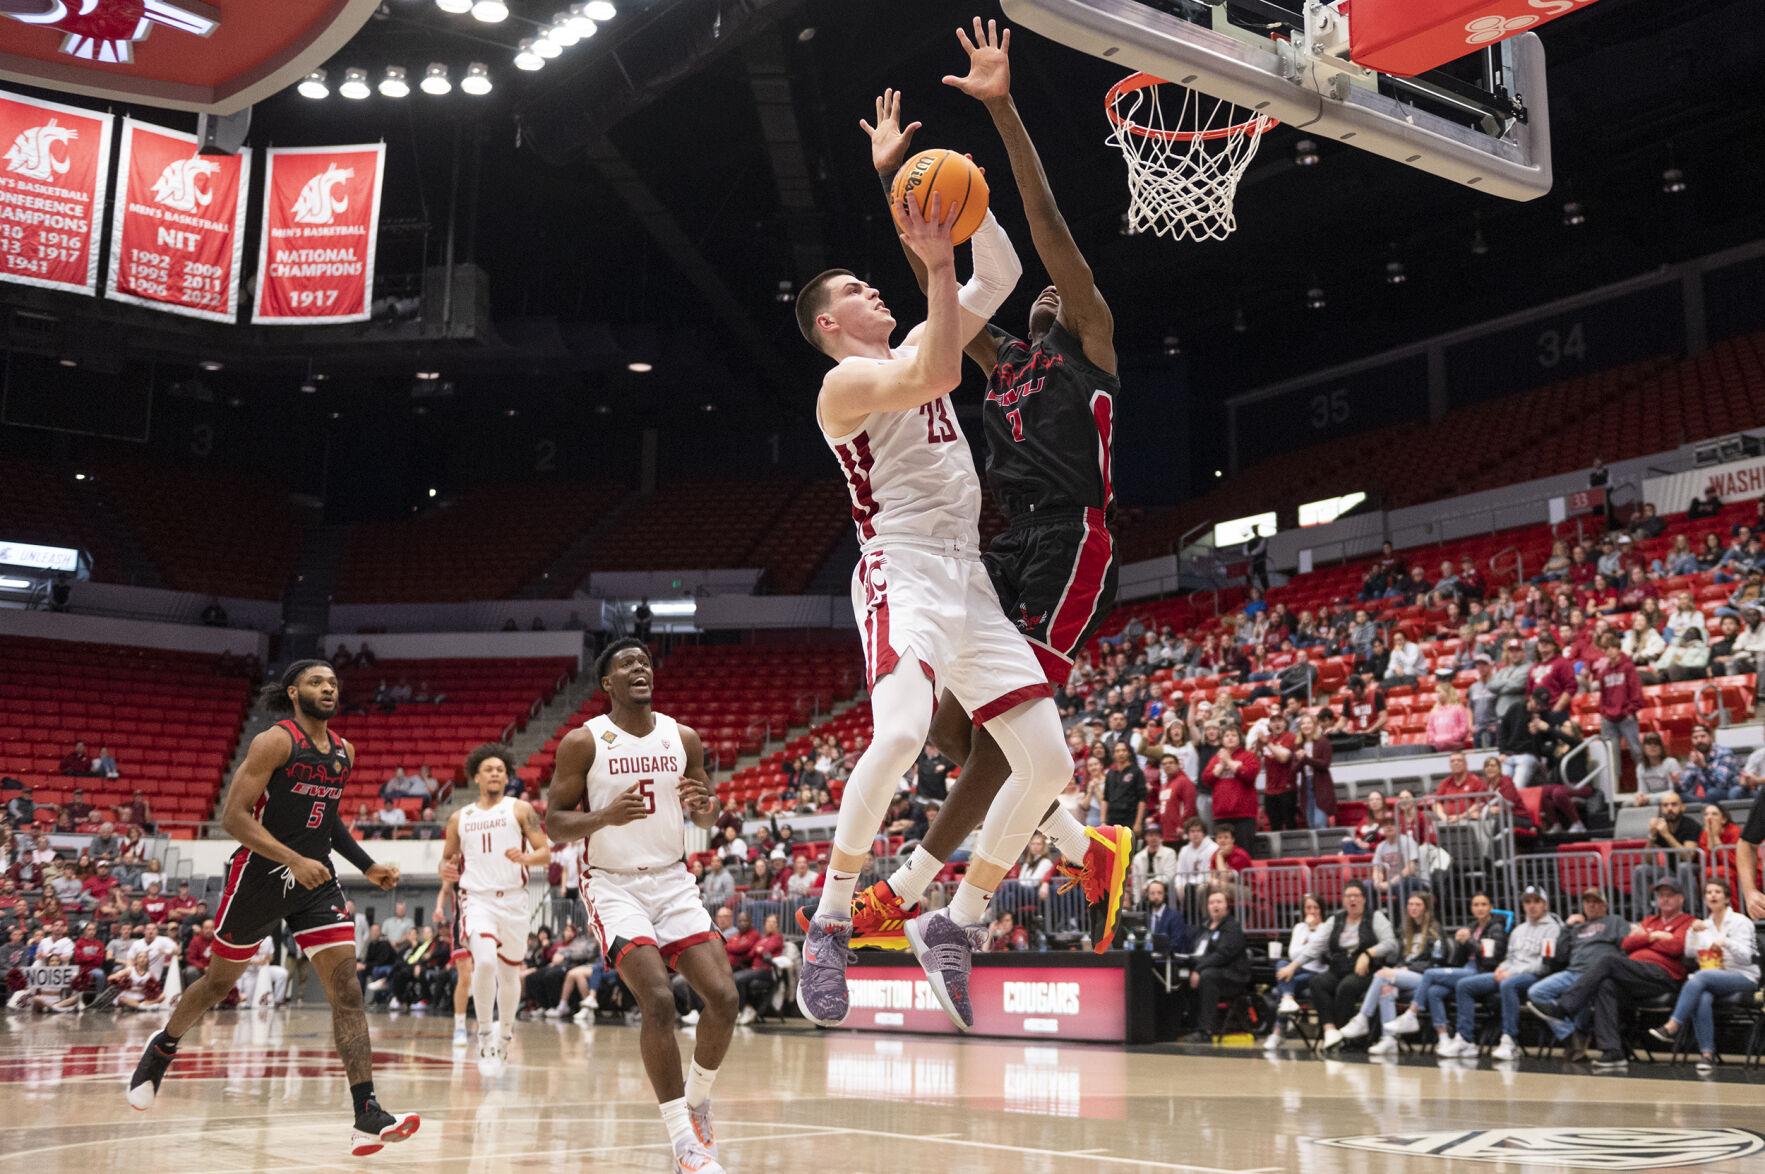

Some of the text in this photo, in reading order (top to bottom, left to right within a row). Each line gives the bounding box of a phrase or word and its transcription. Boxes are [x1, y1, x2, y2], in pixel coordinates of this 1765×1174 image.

[17, 181, 90, 202] BASKETBALL
[0, 205, 88, 233] AMPIONS
[129, 203, 229, 232] MEN'S BASKETBALL
[0, 224, 81, 248] 10 1916
[157, 226, 201, 252] NIT
[271, 225, 366, 238] MEN'S BASKETBALL
[7, 255, 47, 273] 1941
[38, 245, 80, 263] 1917
[131, 248, 222, 278] 1992 2009
[276, 248, 357, 263] NATIONAL
[130, 263, 221, 292] 1995 2011
[269, 262, 363, 277] CHAMPIONS
[128, 277, 221, 306] 1996 2022
[290, 290, 339, 308] 1917
[1537, 322, 1586, 367] 34
[1311, 389, 1350, 428] 35
[919, 397, 958, 444] 23
[20, 549, 73, 564] UNLEASH
[608, 756, 678, 775] COUGARS
[290, 782, 342, 800] EWU
[639, 779, 656, 814] 5
[306, 801, 326, 829] 5
[464, 817, 507, 832] COUGARS
[482, 832, 492, 854] 11
[26, 968, 72, 986] NOISE
[1004, 981, 1079, 1014] COUGARS
